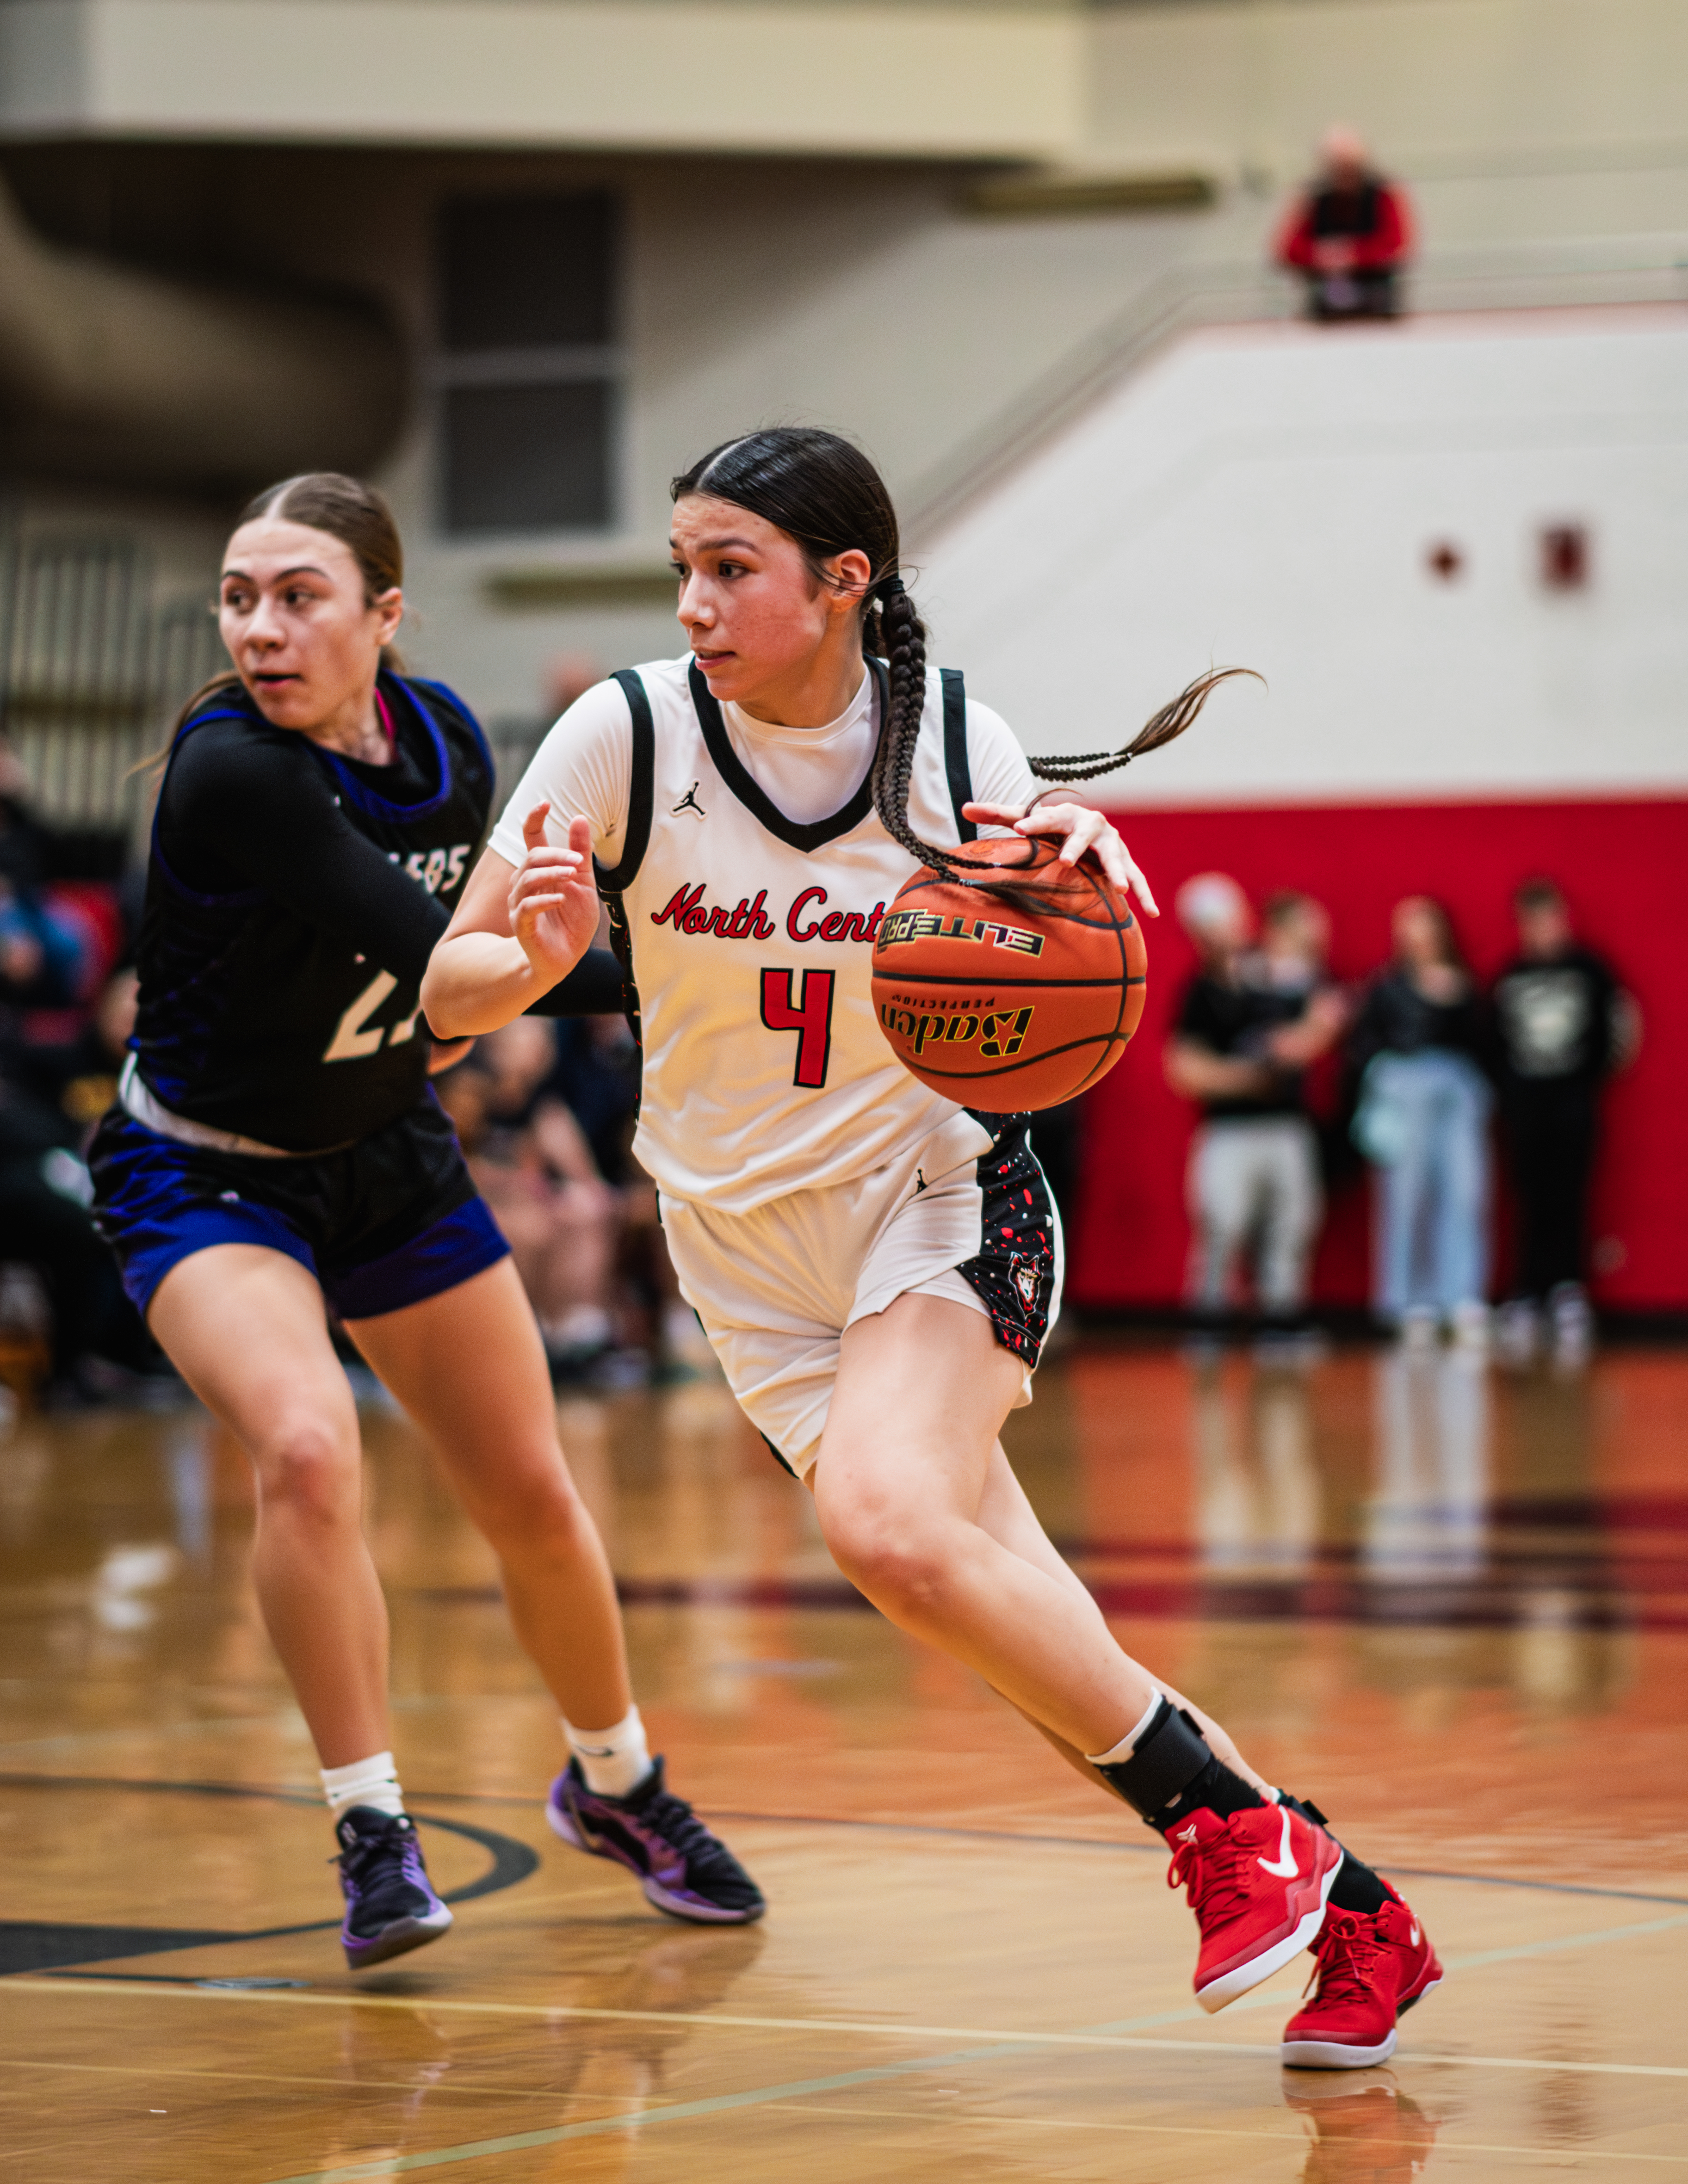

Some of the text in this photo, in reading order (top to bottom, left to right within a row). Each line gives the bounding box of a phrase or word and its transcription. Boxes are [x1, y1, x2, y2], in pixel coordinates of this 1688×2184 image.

[651, 882, 775, 939] North
[878, 910, 1045, 958] ELITE PRO
[760, 968, 835, 1088] 4
[881, 1003, 1035, 1058] Baden
